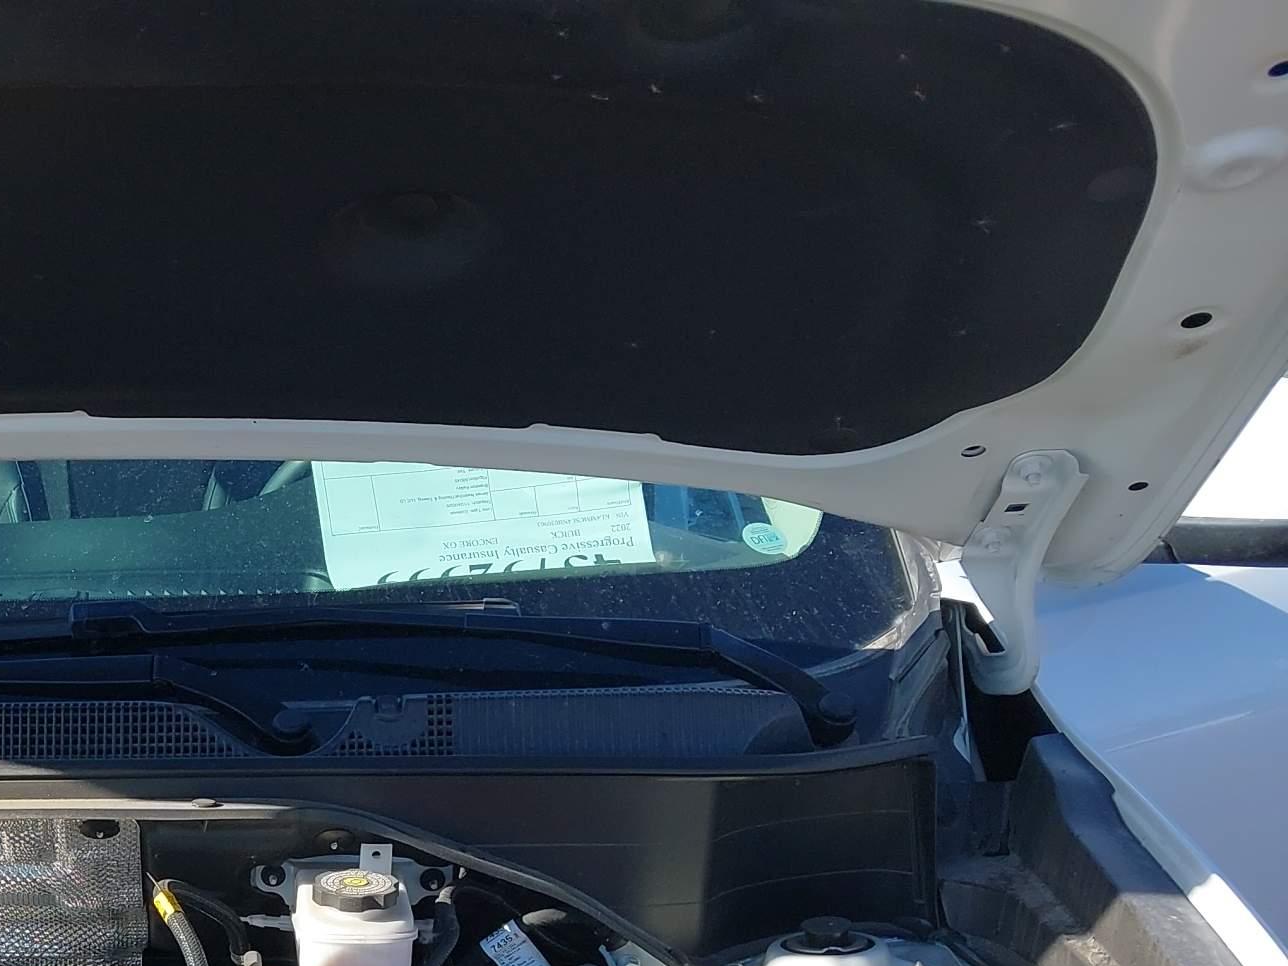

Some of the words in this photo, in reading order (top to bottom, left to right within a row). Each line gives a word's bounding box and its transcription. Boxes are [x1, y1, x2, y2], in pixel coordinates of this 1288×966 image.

[550, 528, 581, 539] BUICK
[611, 522, 631, 533] 2022
[442, 541, 458, 550] GX
[459, 537, 499, 548] ENCORE
[561, 535, 634, 553] Progressive
[439, 549, 500, 562] Insurance
[503, 543, 558, 559] Casualty
[490, 934, 513, 953] 7435
